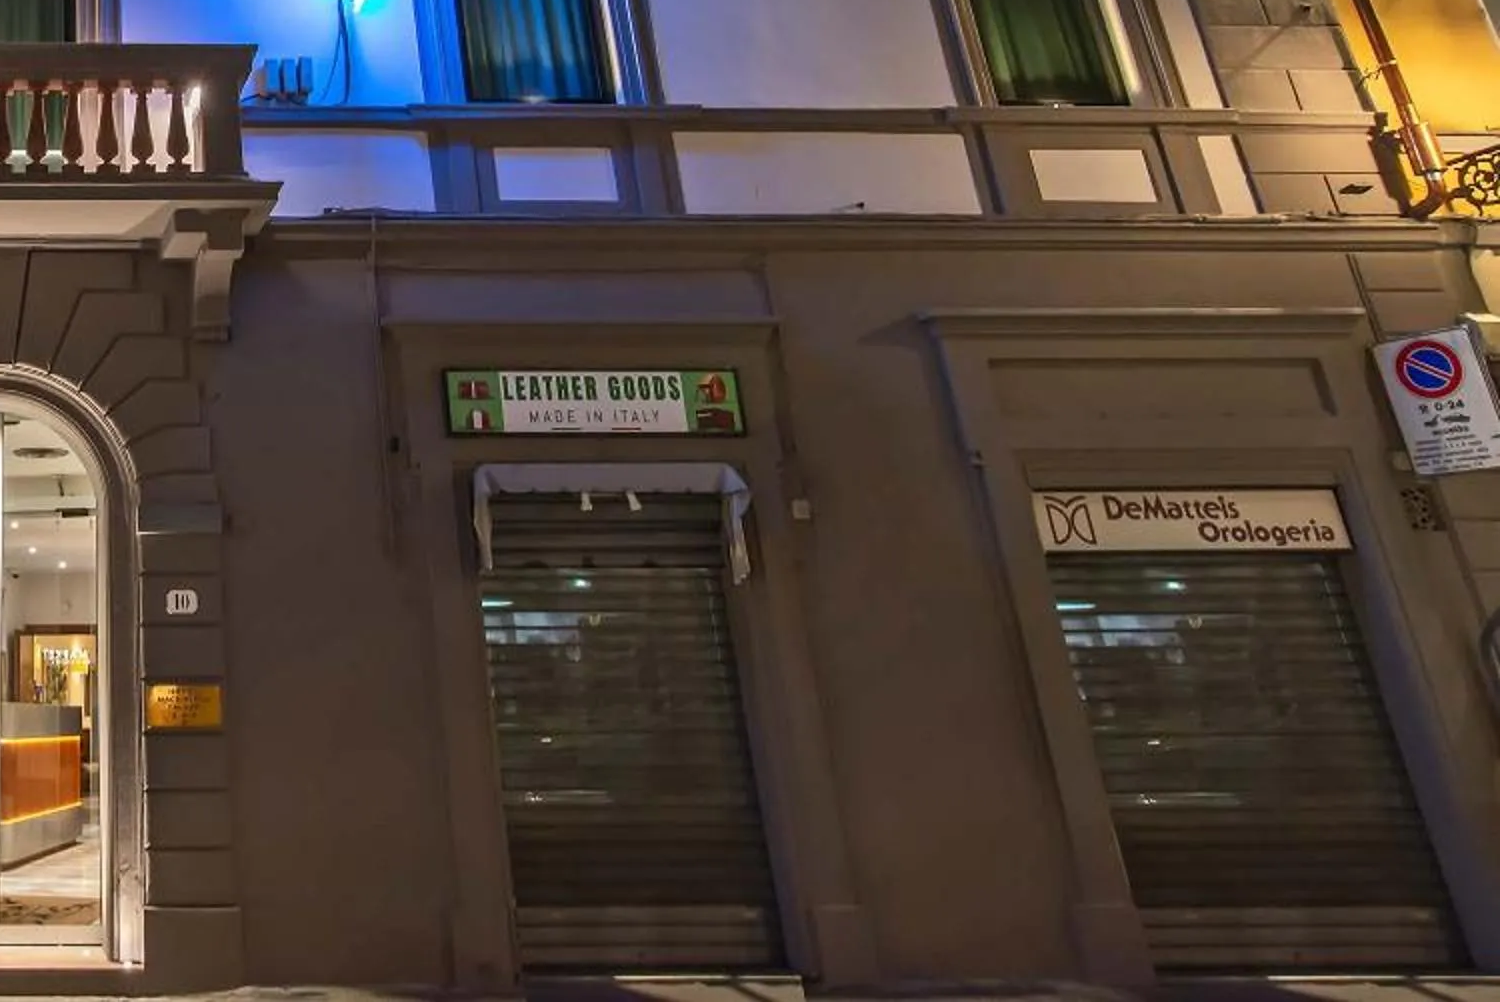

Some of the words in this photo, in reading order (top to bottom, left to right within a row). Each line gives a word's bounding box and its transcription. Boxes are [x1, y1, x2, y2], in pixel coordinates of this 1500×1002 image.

[502, 374, 599, 401] LEATHER
[607, 375, 681, 402] GOODS
[529, 409, 576, 424] MADE
[586, 409, 604, 424] IN
[613, 409, 661, 424] ITALY
[1102, 495, 1240, 521] DeMatteis
[1198, 519, 1335, 547] Orologeria
[174, 593, 192, 611] 10
